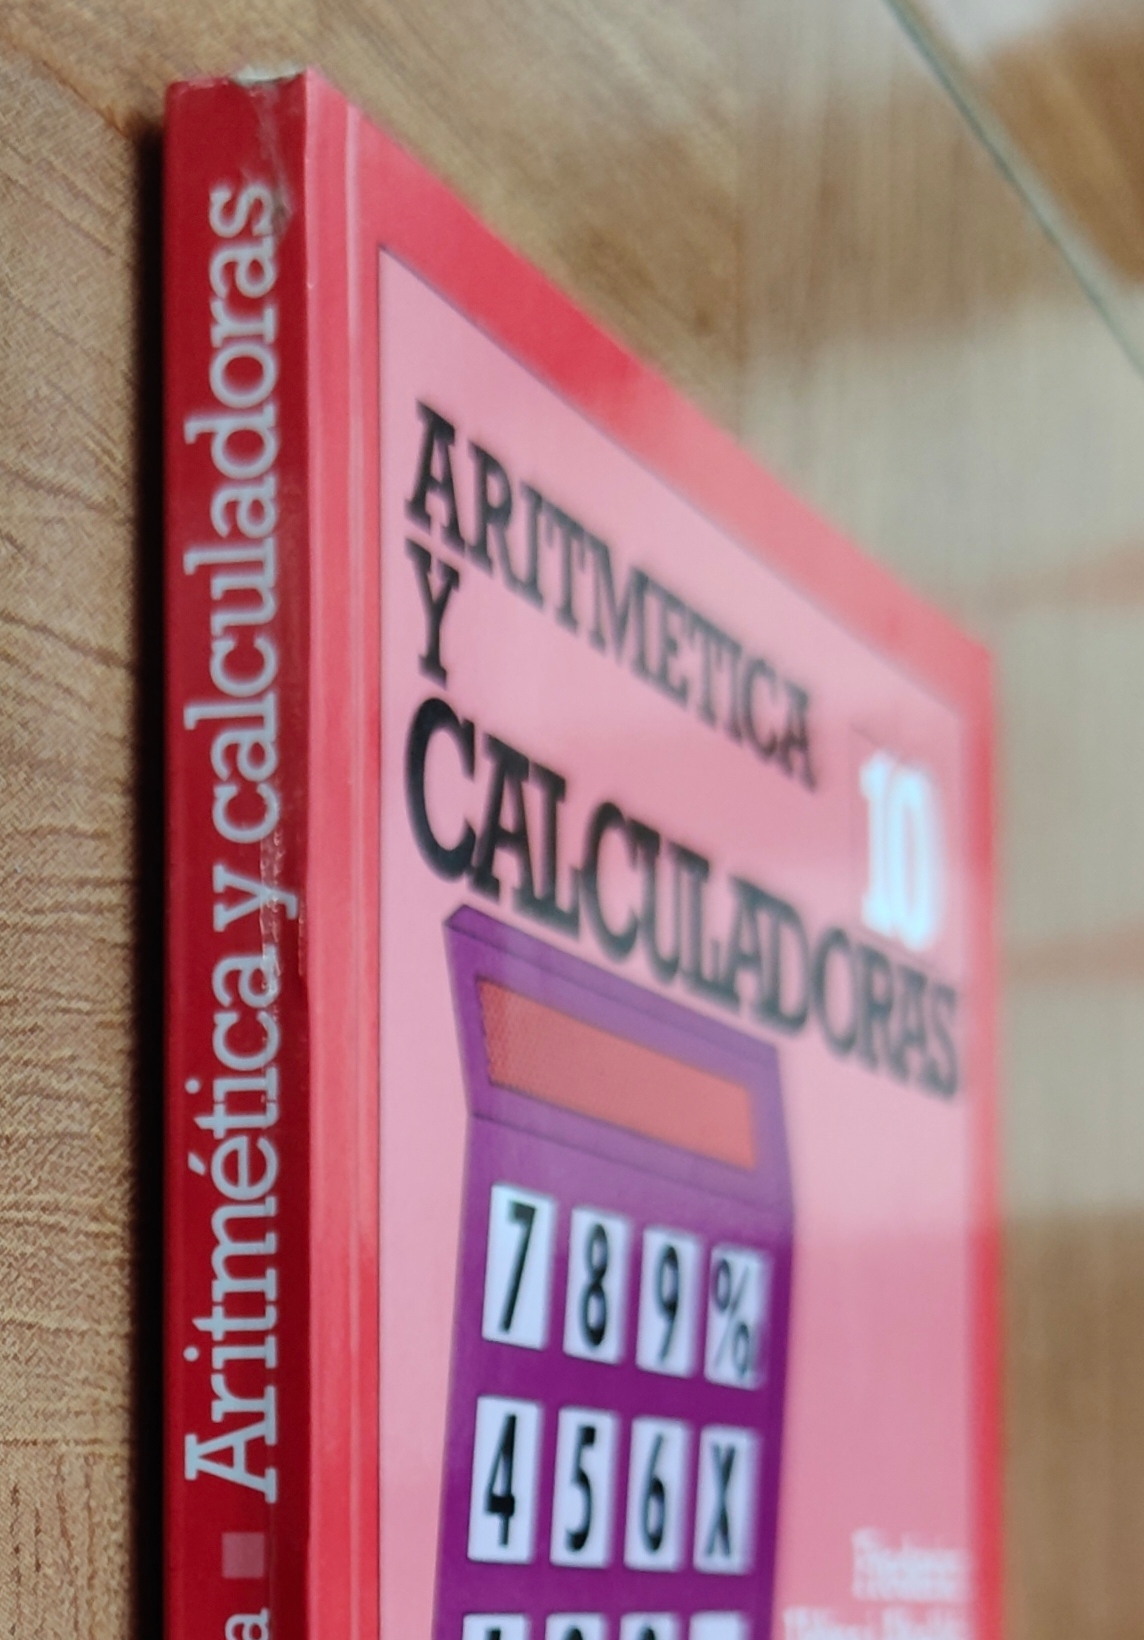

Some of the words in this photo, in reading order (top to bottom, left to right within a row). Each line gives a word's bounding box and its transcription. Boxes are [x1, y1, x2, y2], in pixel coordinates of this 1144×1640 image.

[182, 182, 280, 844] calculadoras
[405, 398, 818, 794] ARITMETICA
[405, 536, 460, 690] Y
[212, 862, 297, 933] y
[404, 696, 960, 1102] CALCULADORAS
[860, 752, 942, 952] 10
[184, 945, 280, 1503] Aritmética
[505, 1203, 537, 1333] 7
[576, 1222, 609, 1347] 8
[658, 1243, 680, 1361] 9
[487, 1414, 516, 1546] 4
[566, 1426, 596, 1553] 5
[641, 1433, 666, 1555] 6
